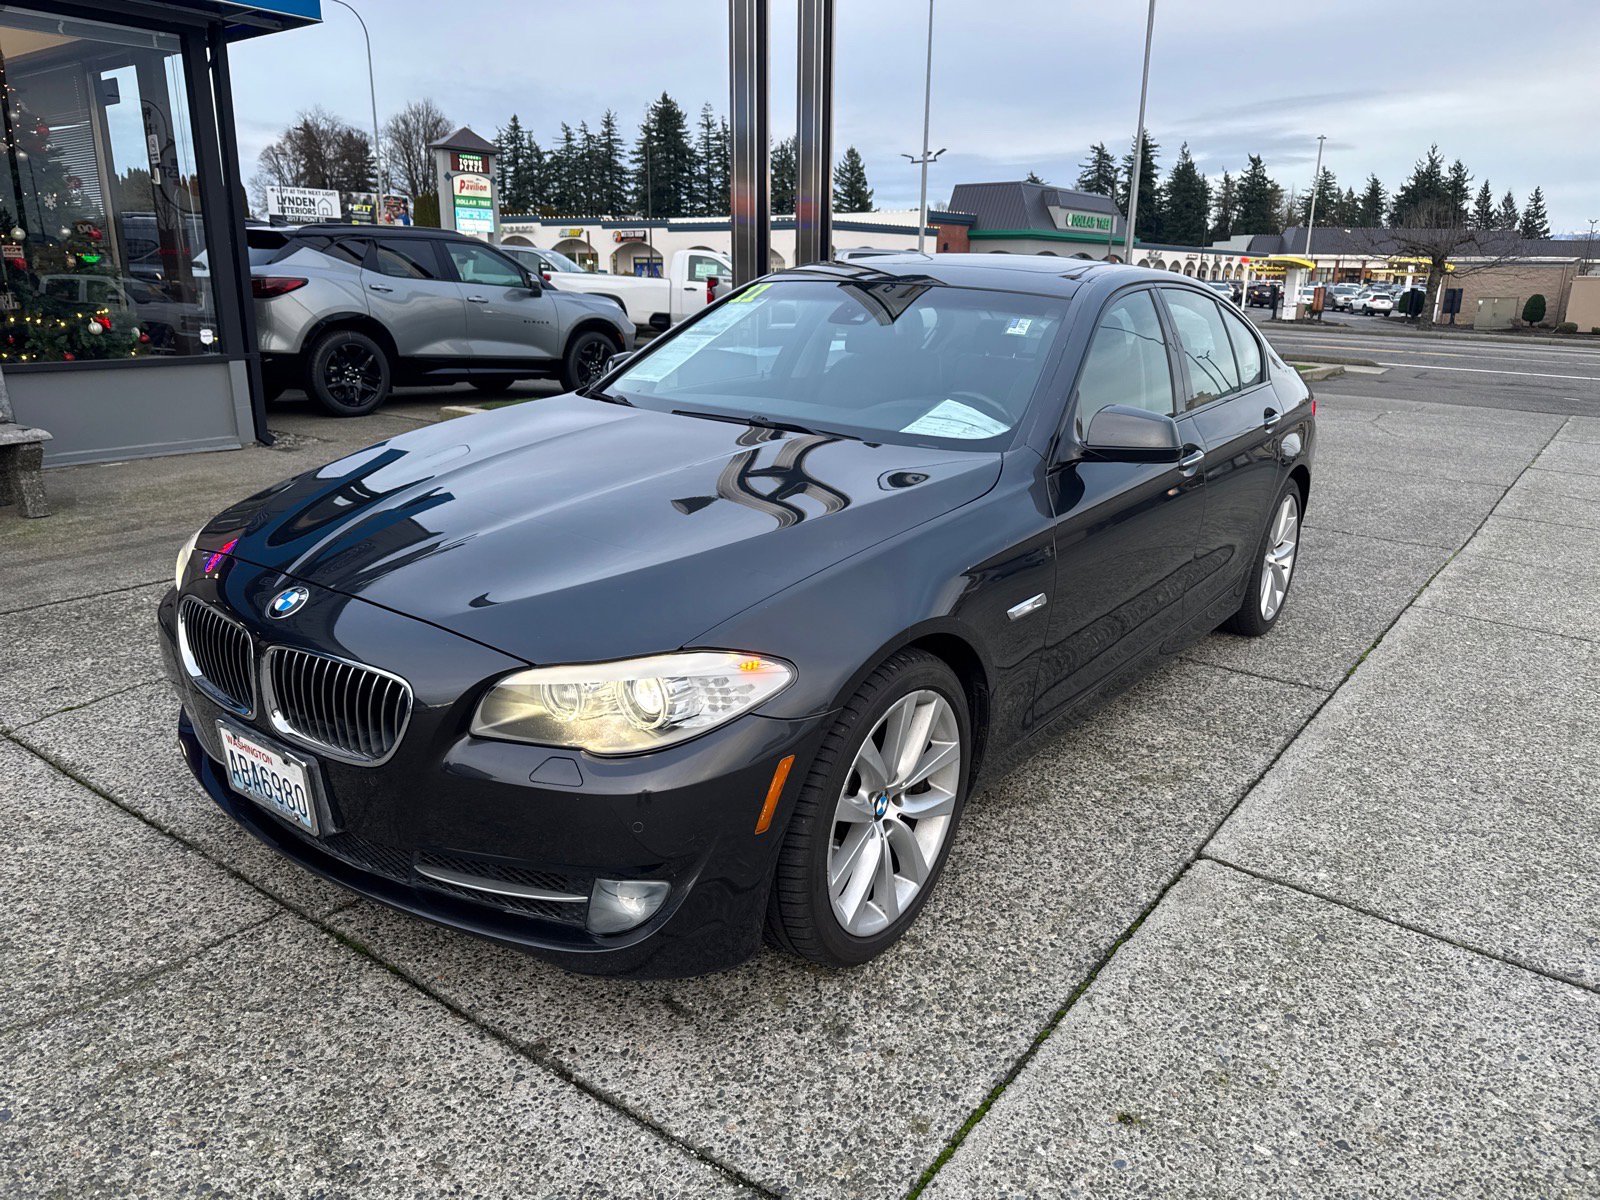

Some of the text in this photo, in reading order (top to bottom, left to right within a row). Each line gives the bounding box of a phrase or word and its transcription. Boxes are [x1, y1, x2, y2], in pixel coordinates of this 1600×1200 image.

[459, 180, 487, 194] Pavilion
[277, 196, 315, 206] LYNDEN
[1072, 214, 1095, 228] DOLLAR
[226, 734, 273, 766] WASHINGTON
[229, 749, 307, 818] ABA6980
